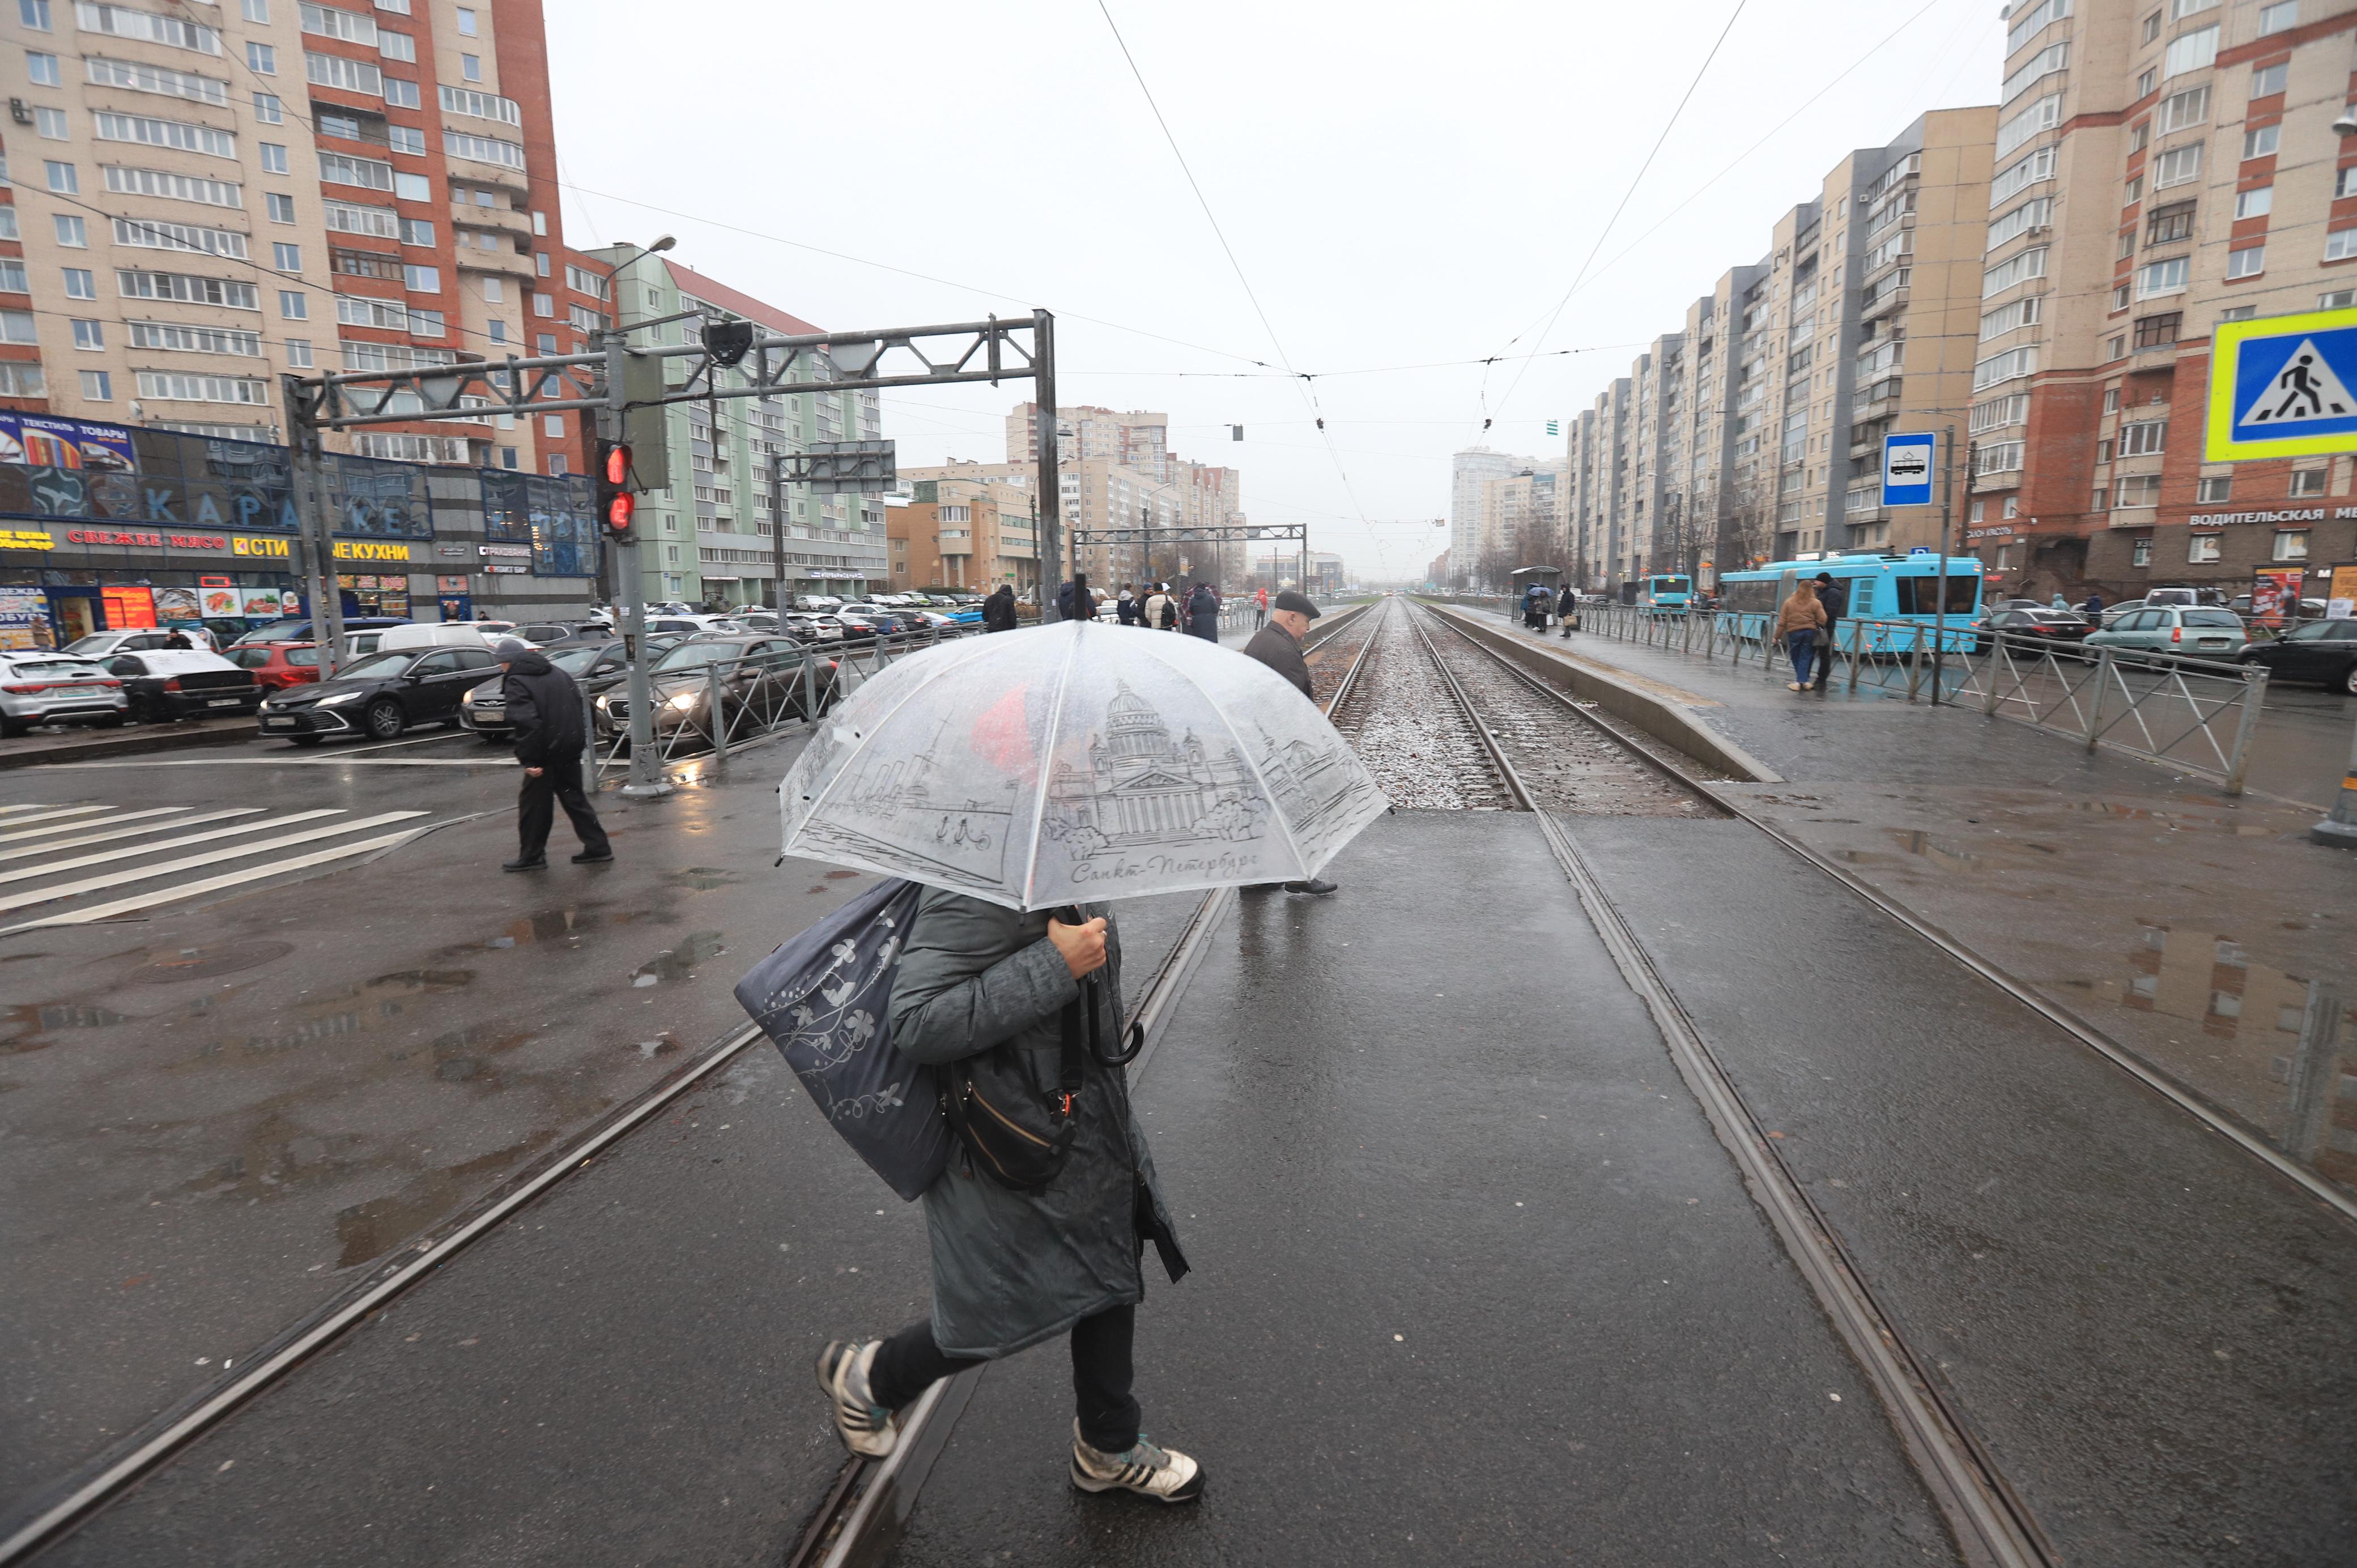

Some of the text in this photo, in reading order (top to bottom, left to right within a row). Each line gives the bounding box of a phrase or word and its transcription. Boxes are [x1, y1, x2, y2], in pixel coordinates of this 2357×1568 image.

[22, 418, 75, 432] ТЕКСТИЛЬ
[79, 425, 127, 440] ТОВАРЫ
[146, 487, 402, 535] КАРАКЕ
[2189, 509, 2325, 526] ВОДИТЕЛЬСКАЯ
[67, 530, 226, 549] СВЕЖЕЕ МЯСО
[352, 543, 409, 560] КУХНИ
[479, 546, 532, 557] СТРАХОВАНИЕ
[1071, 852, 1258, 883] Санкт-Петербург
